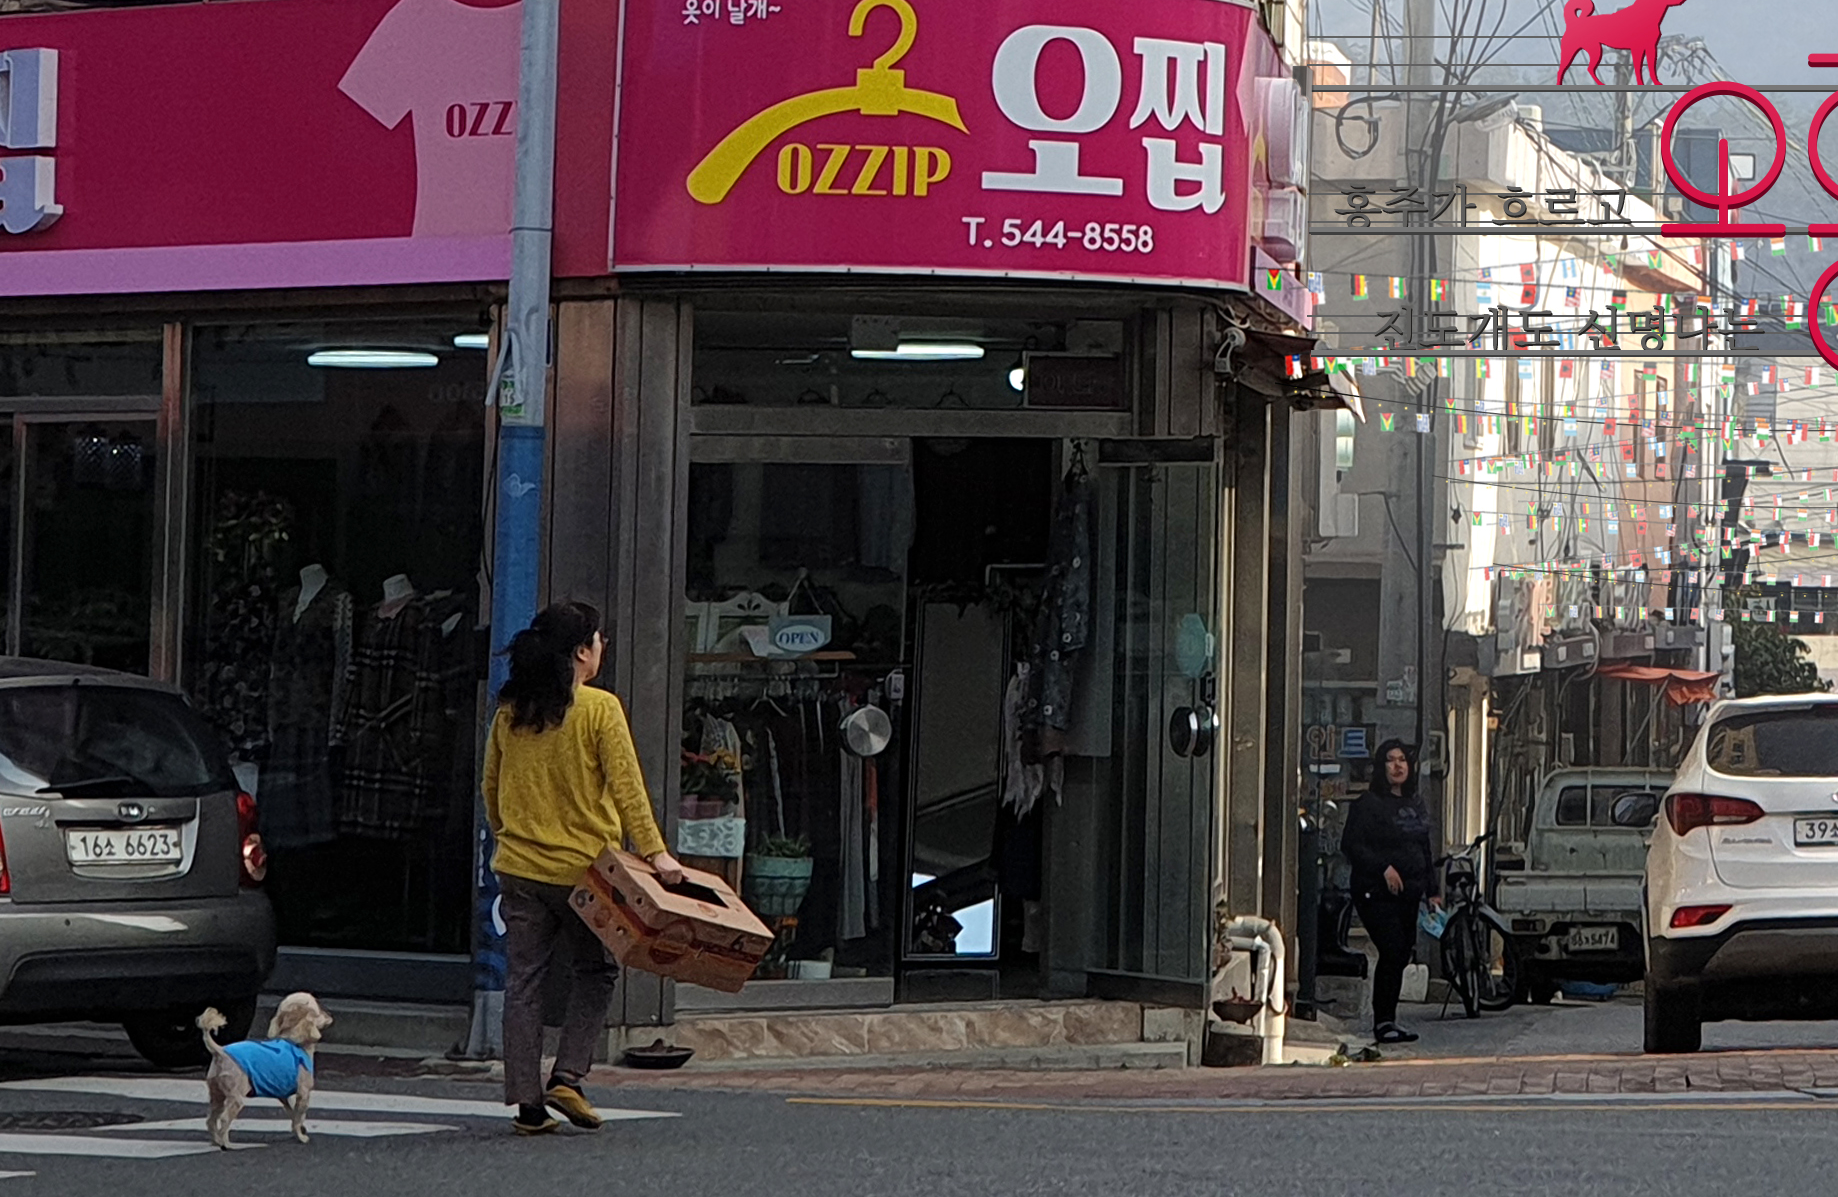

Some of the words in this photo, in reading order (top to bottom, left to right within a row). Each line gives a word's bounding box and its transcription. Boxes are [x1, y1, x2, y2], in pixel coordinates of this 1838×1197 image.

[444, 101, 516, 139] OZZ
[776, 143, 952, 197] OZZIP
[1335, 183, 1477, 230] 홍주가
[1491, 185, 1632, 225] 흐르고
[1374, 305, 1562, 351] 진도개도
[1577, 305, 1766, 352] 신명나는
[779, 631, 820, 645] OPEN
[80, 834, 117, 857] 16소
[125, 834, 171, 856] 6623
